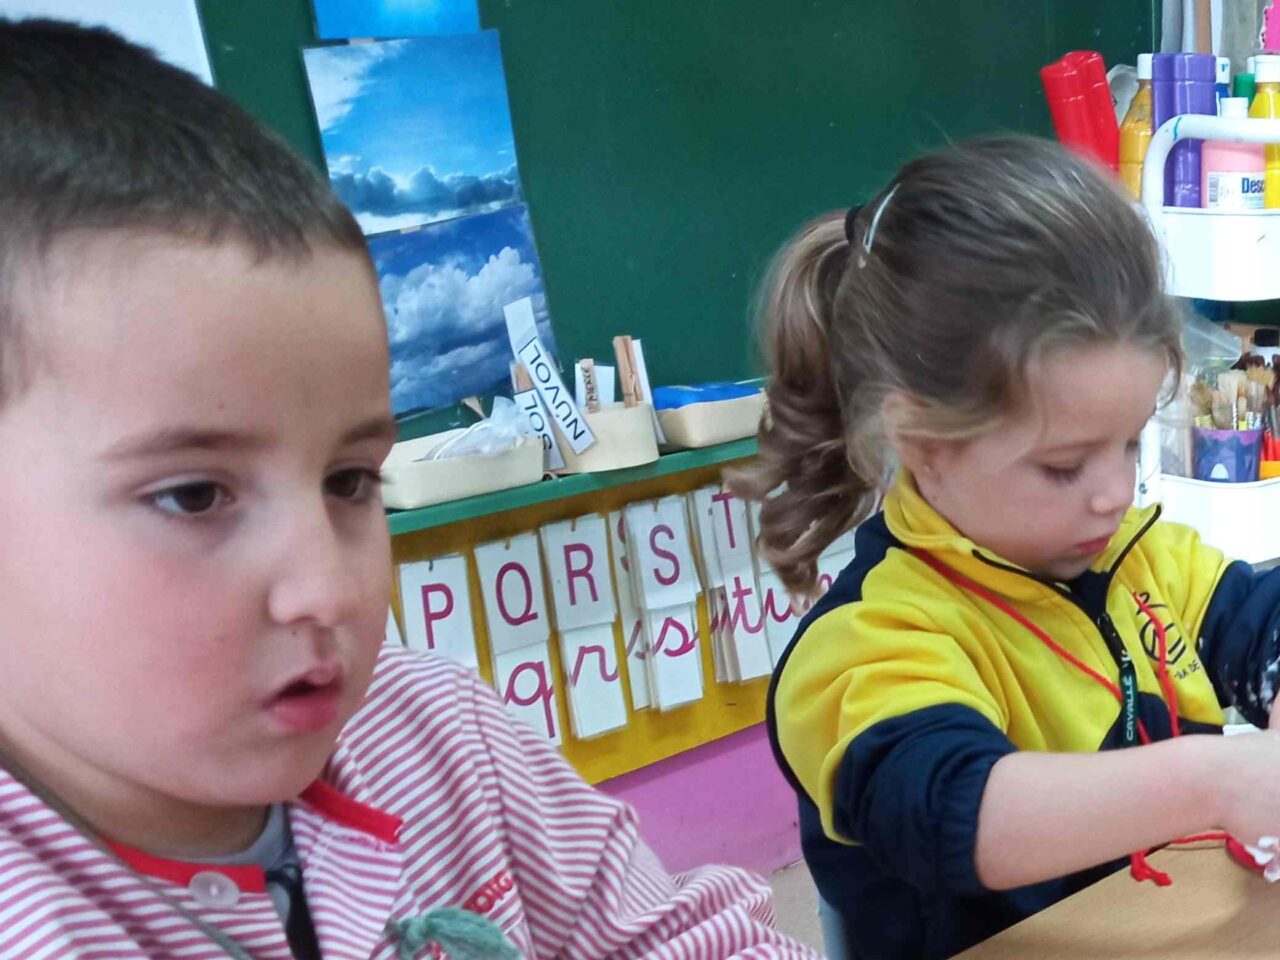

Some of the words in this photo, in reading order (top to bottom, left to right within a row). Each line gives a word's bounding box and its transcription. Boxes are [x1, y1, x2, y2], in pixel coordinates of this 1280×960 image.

[529, 343, 585, 441] NÚVOL
[421, 583, 454, 650] P
[495, 561, 538, 626] Q
[563, 543, 600, 606] R
[649, 524, 680, 586] S
[712, 492, 737, 549] T
[505, 661, 554, 739] q
[652, 617, 698, 658] s
[731, 576, 764, 634] t
